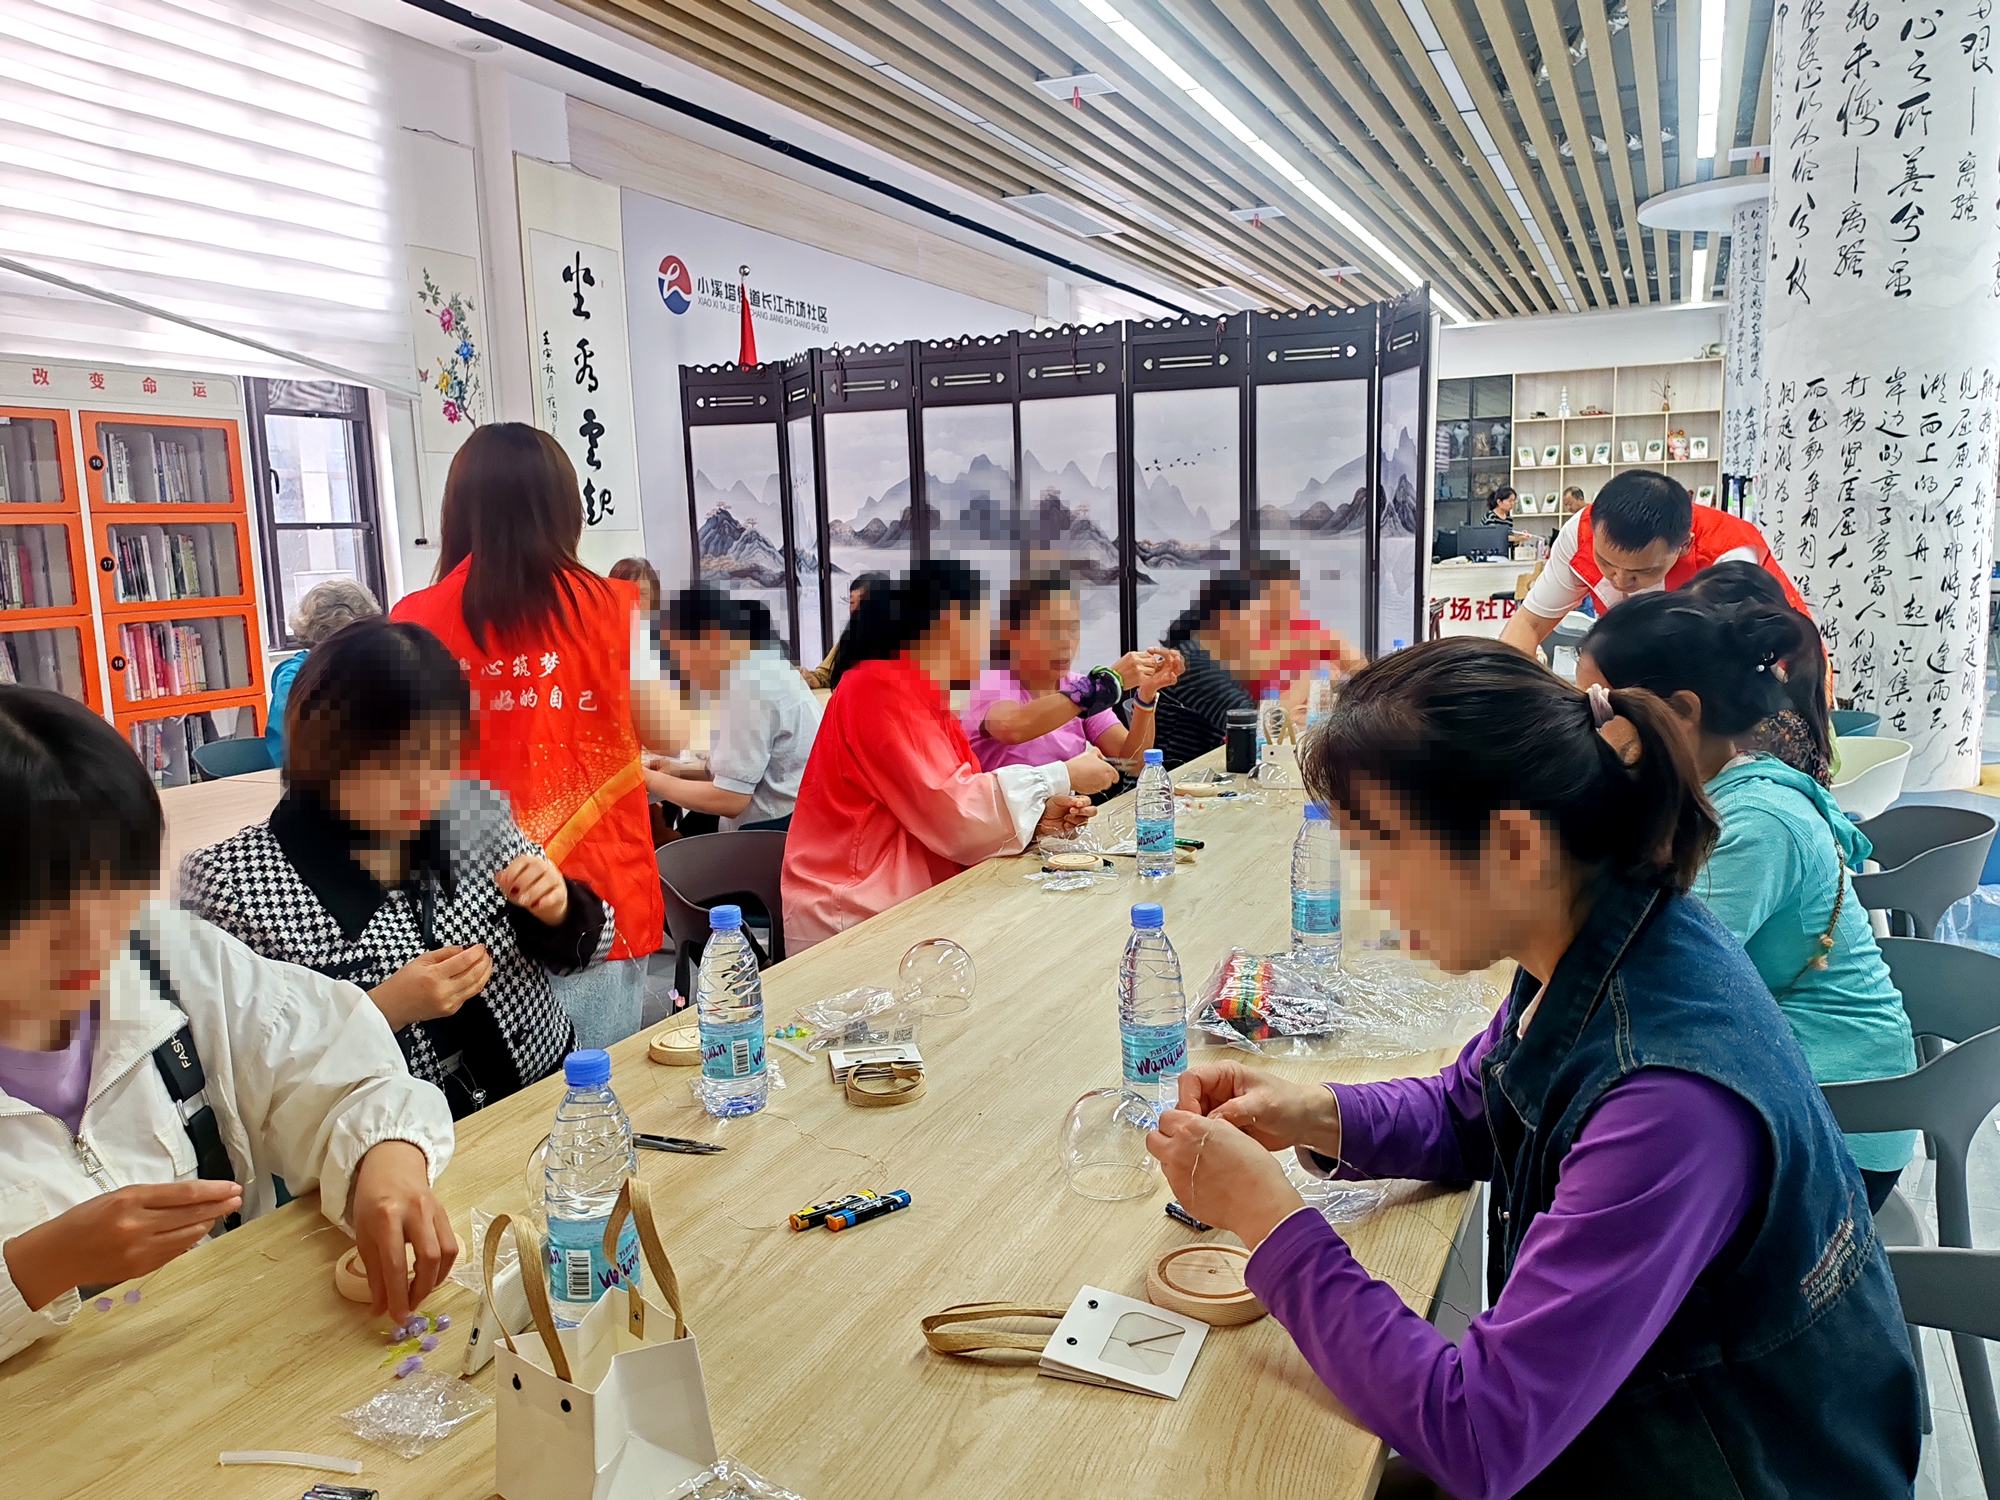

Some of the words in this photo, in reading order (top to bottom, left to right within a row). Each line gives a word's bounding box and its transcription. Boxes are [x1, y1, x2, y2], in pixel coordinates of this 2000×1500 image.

[698, 296, 712, 308] XIAO
[713, 299, 719, 310] XI
[720, 301, 727, 312] TA
[32, 368, 207, 398] 改变命运
[1430, 596, 1516, 621] 场社区
[470, 685, 598, 711] 好的自己
